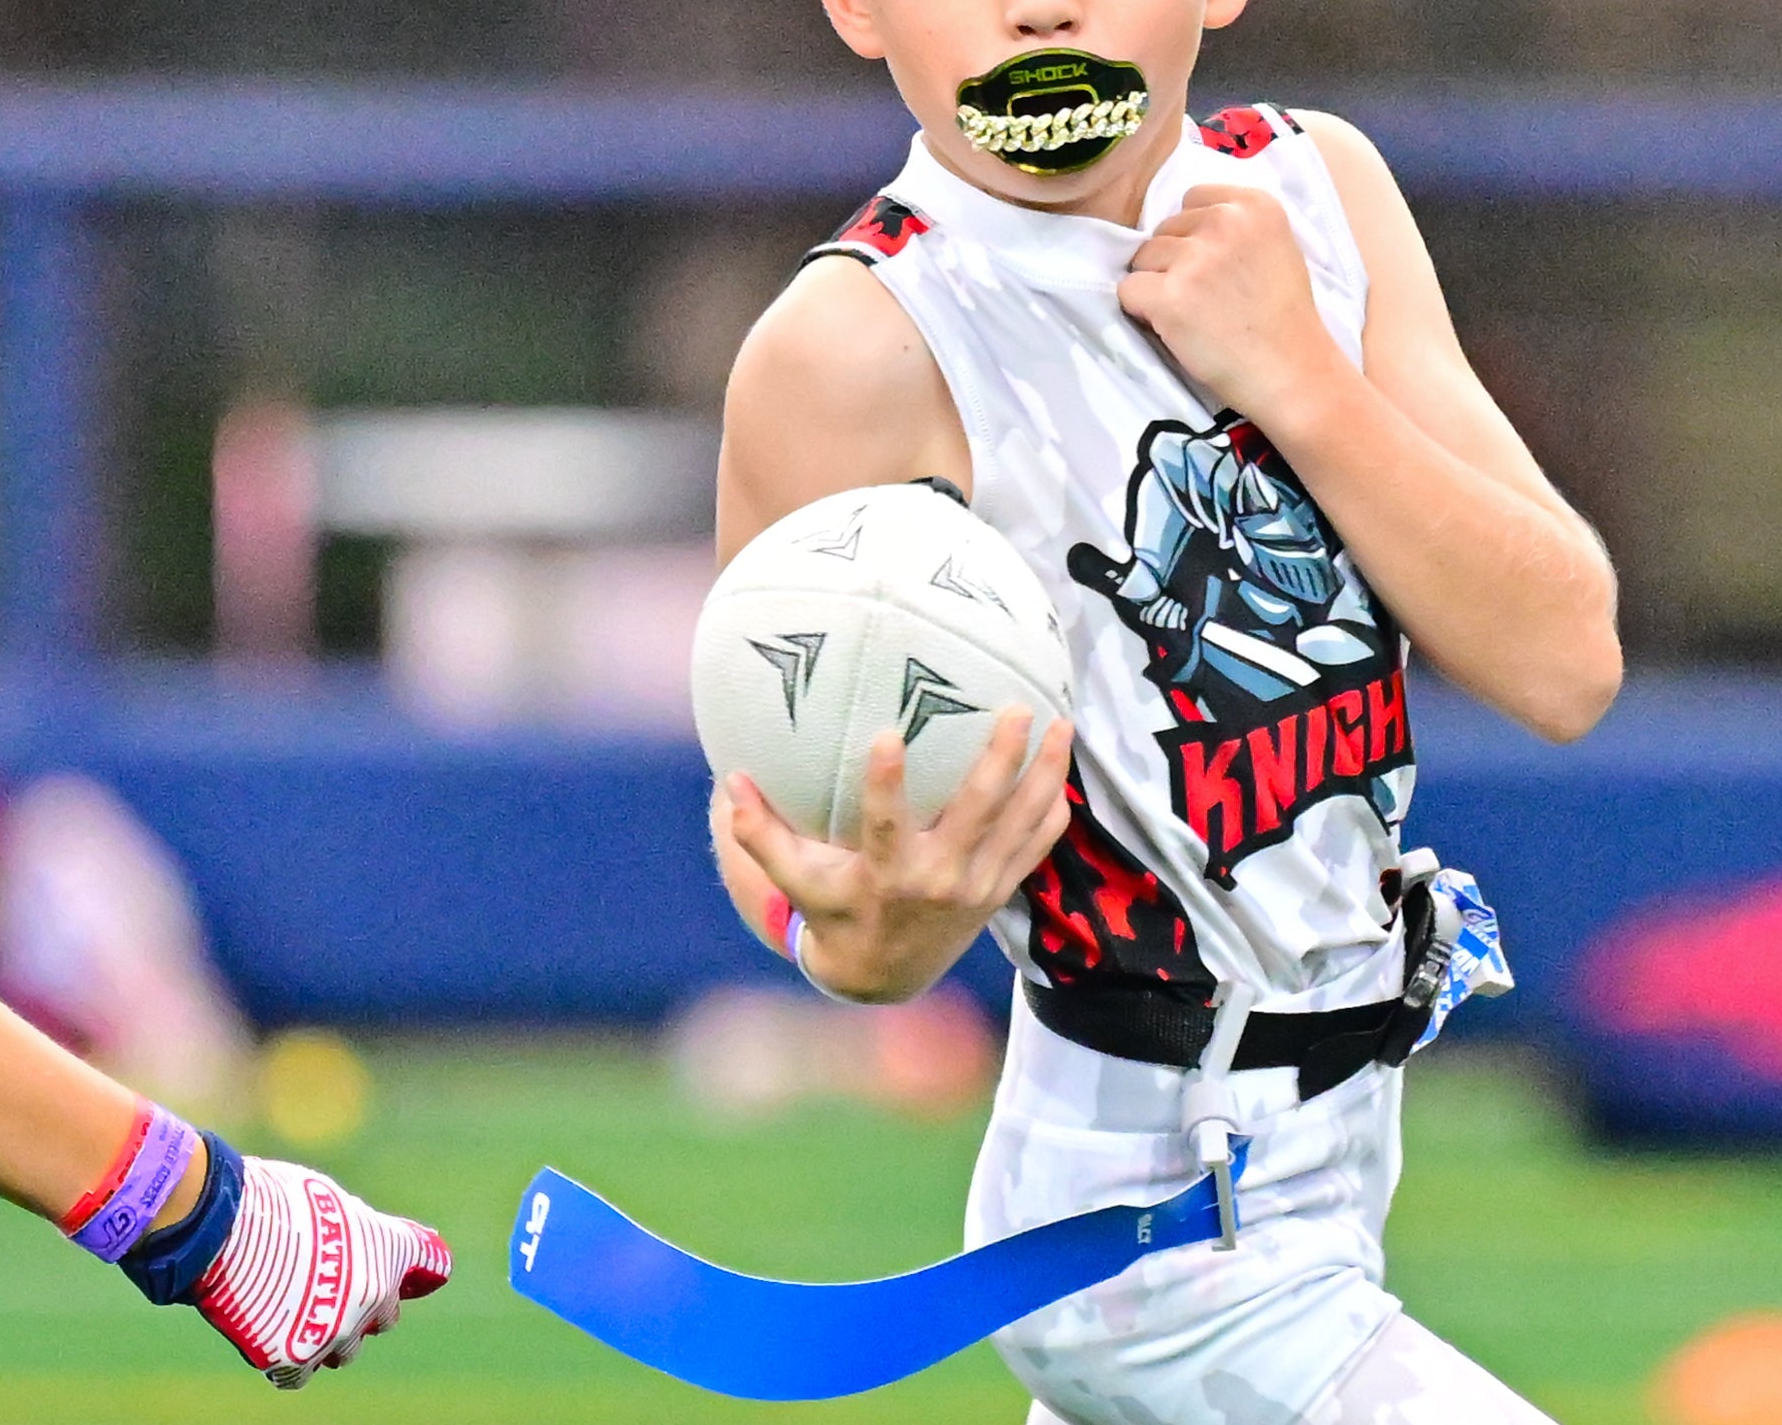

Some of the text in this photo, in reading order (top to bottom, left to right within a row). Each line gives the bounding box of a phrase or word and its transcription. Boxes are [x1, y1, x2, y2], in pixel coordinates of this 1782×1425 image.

[1009, 61, 1088, 85] SHOCK
[1180, 667, 1406, 853] KNIGH
[299, 1192, 343, 1347] BATTLE
